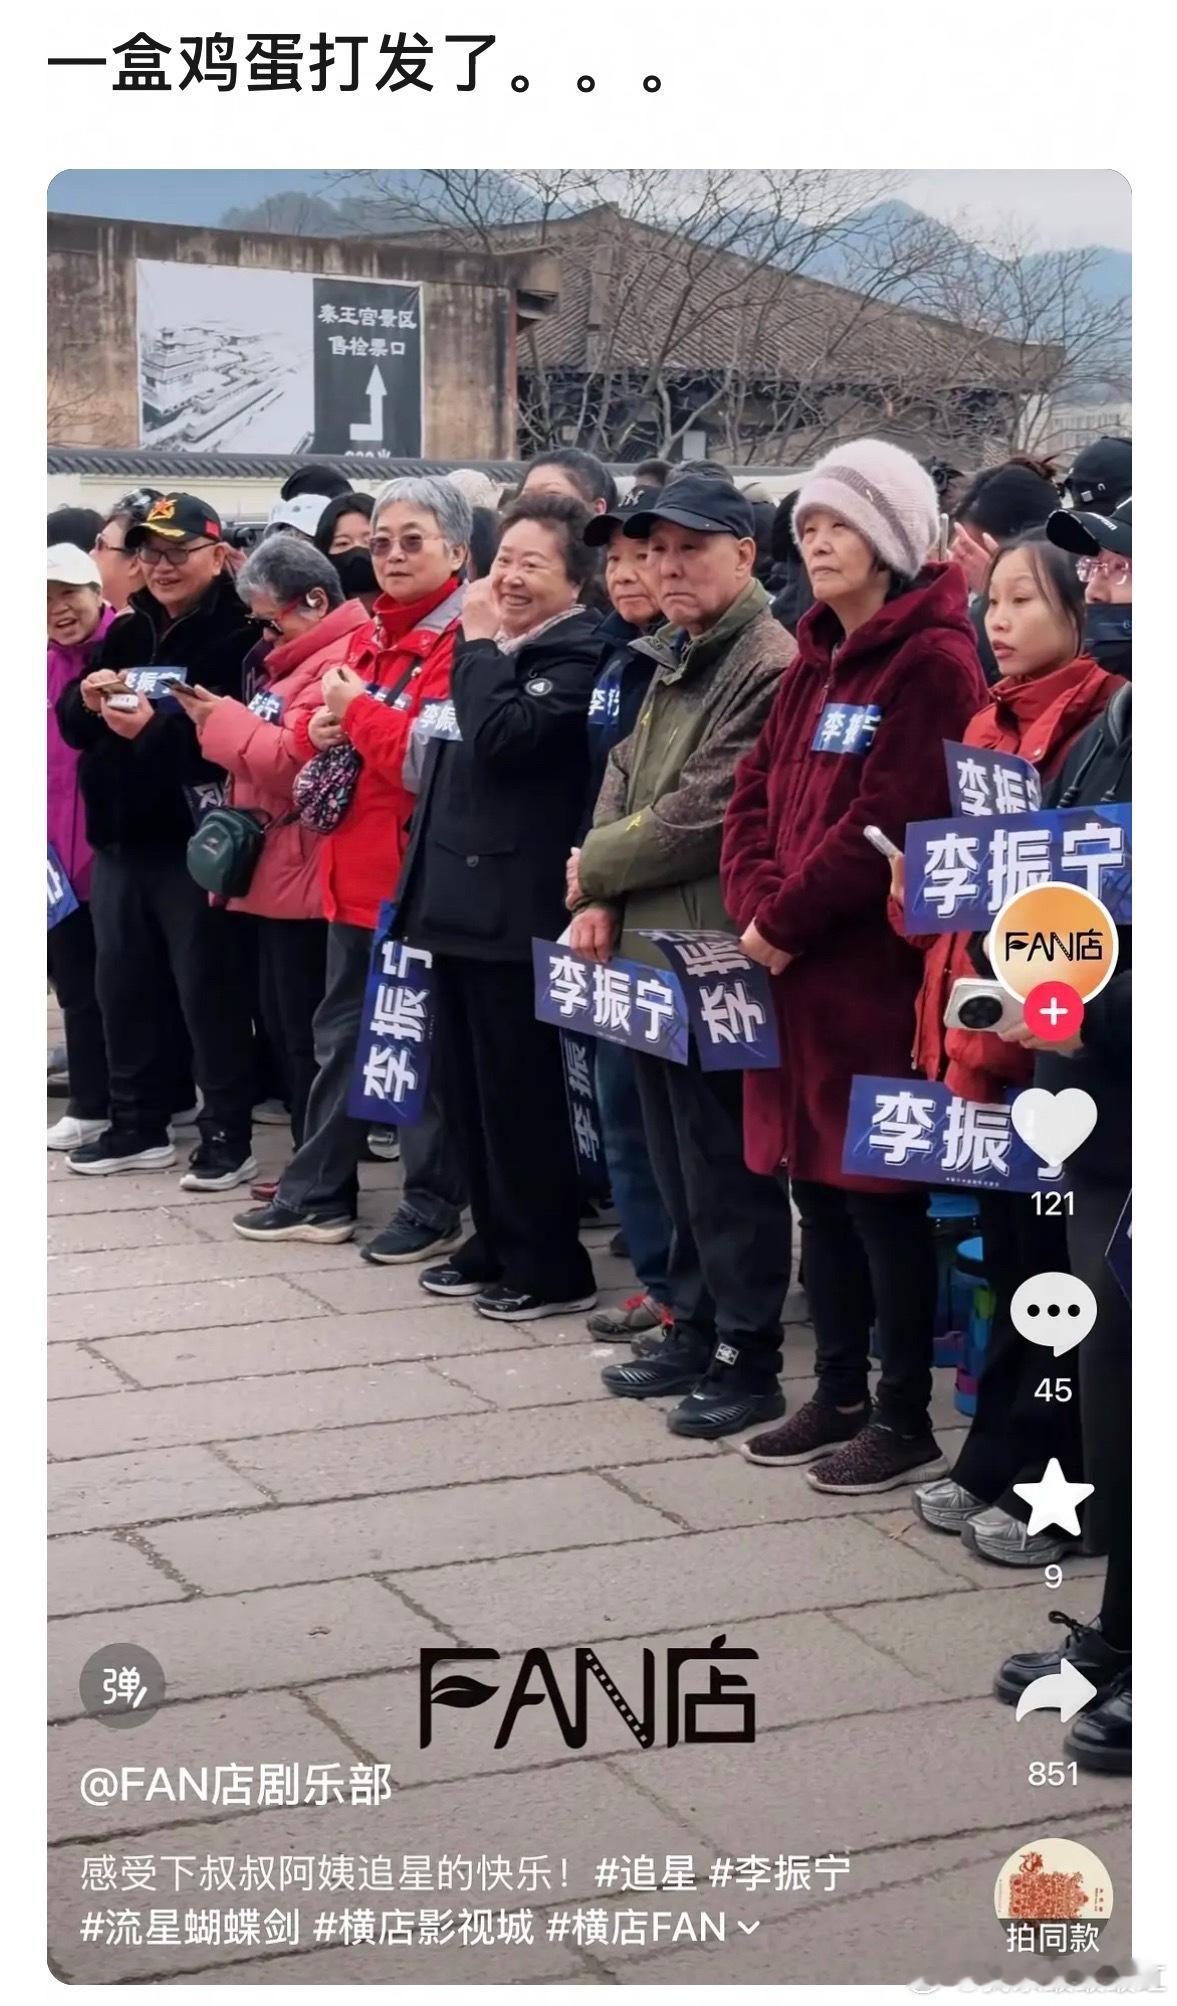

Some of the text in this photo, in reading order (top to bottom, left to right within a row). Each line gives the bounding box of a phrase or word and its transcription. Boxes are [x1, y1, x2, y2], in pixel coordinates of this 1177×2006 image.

[317, 303, 417, 329] 秦王宫景区
[328, 335, 405, 357] 售检票口
[549, 955, 675, 1043] 李振宁
[868, 1091, 1064, 1181] 李振
